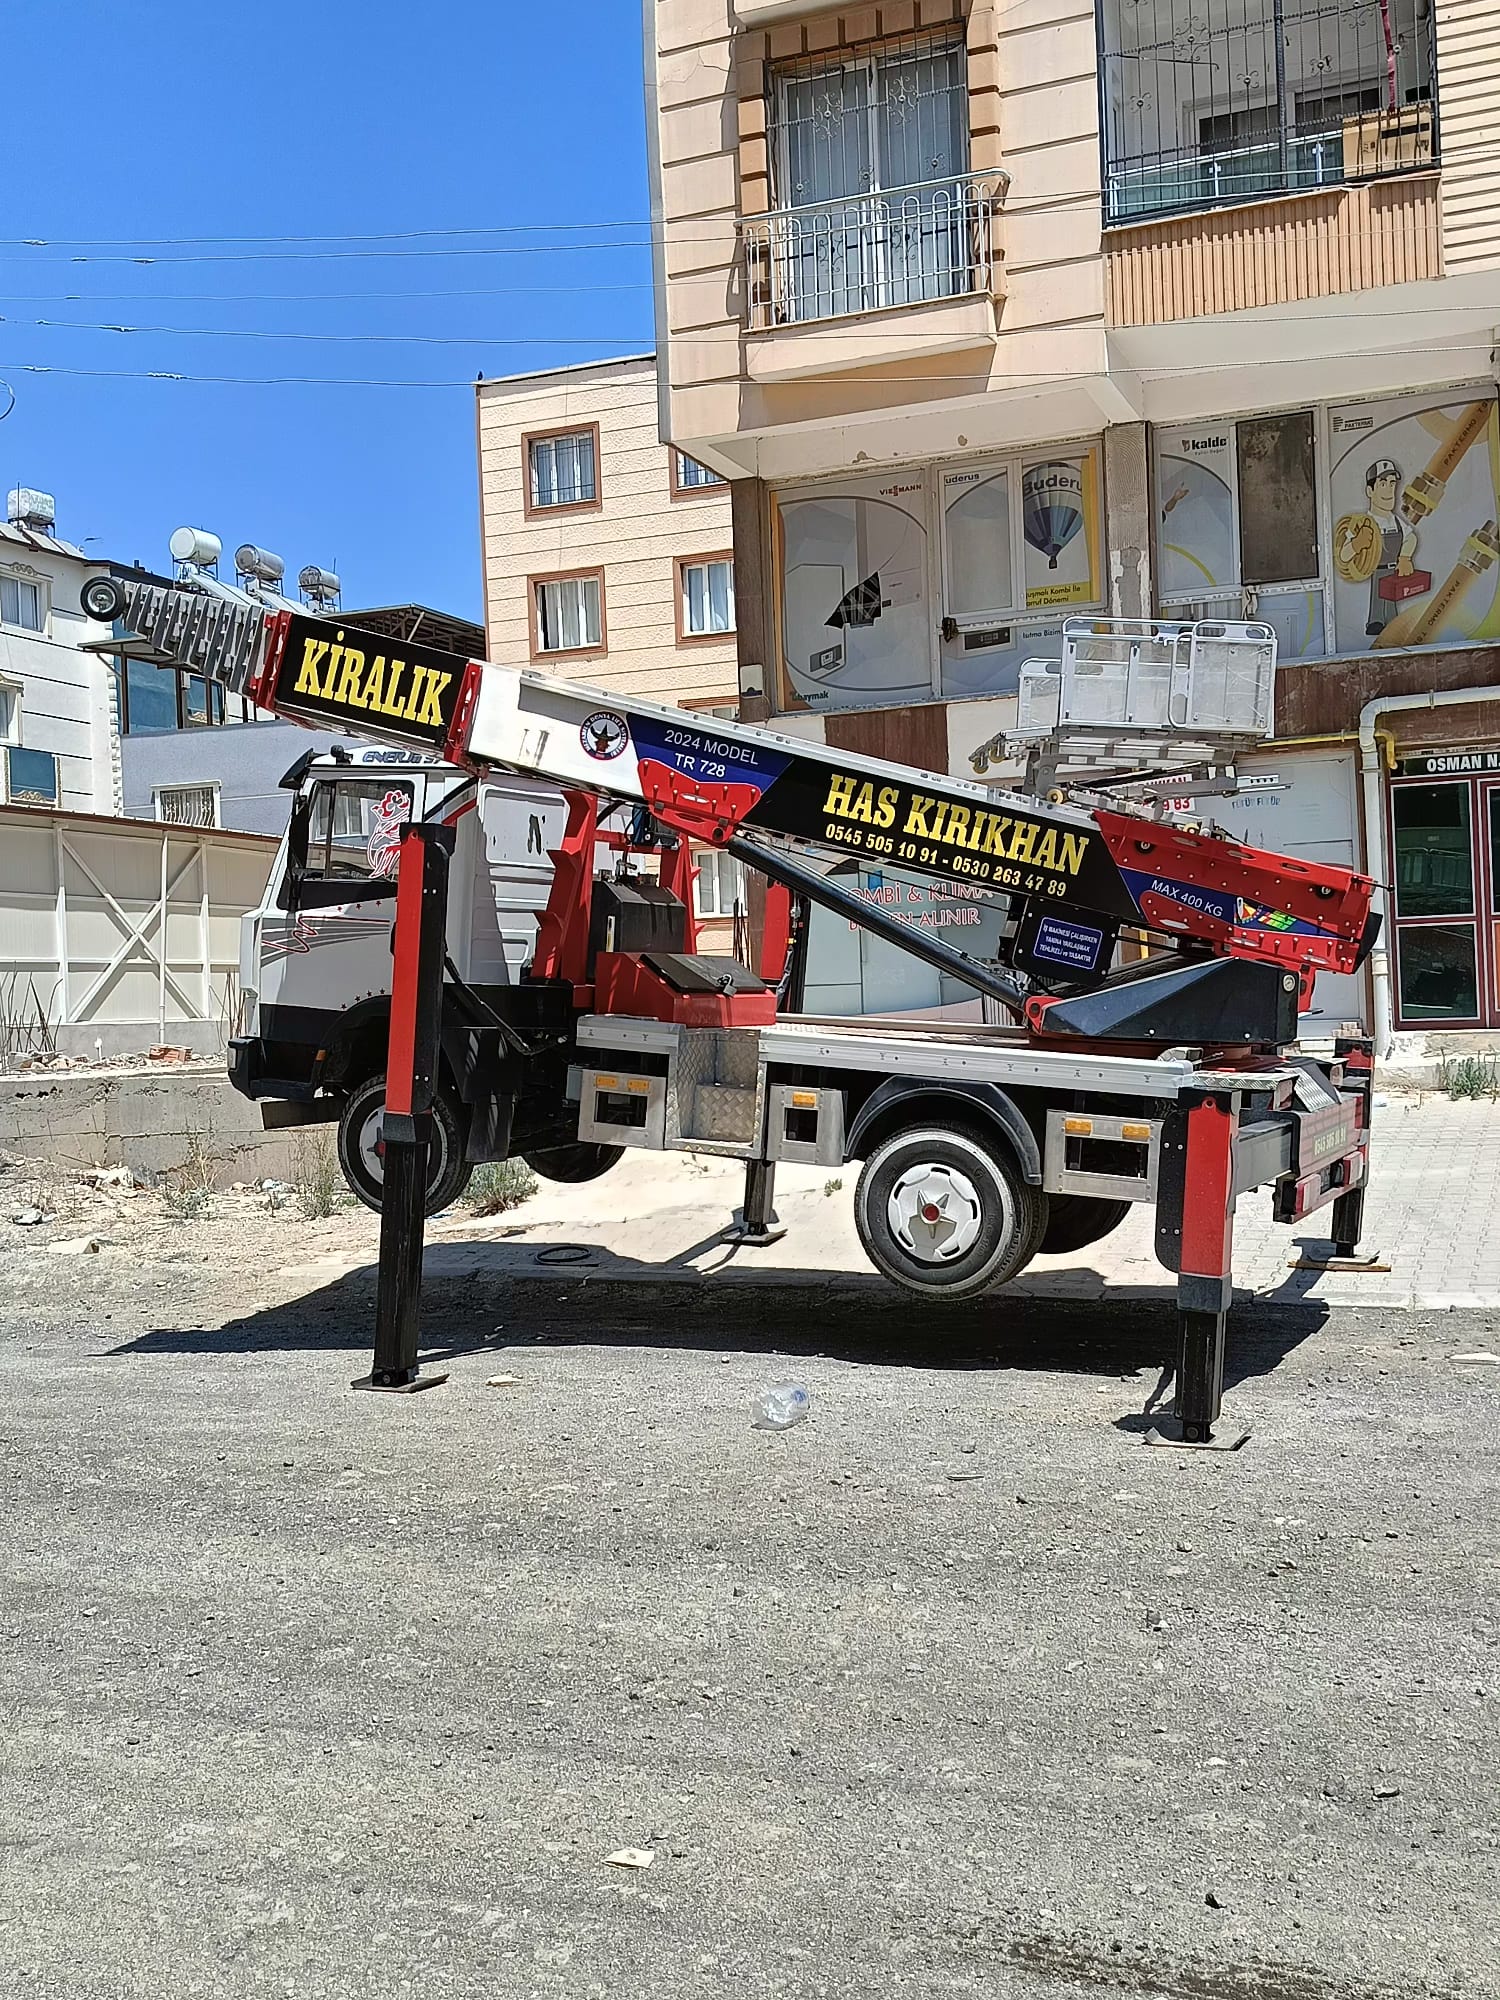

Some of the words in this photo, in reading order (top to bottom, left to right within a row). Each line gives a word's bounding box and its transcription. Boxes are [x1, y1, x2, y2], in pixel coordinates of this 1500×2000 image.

[1043, 594, 1069, 605] Dönemi
[1050, 585, 1071, 595] Kombi
[1043, 629, 1061, 637] Bizim
[293, 630, 453, 728] KİRALIK
[664, 729, 701, 750] 2024
[703, 739, 760, 766] MODEL
[674, 752, 695, 772] TR
[698, 759, 727, 778] 728
[1426, 754, 1482, 773] OSMAN
[822, 773, 900, 829] HAS
[902, 793, 1090, 876] KIRIKHAN
[825, 823, 862, 846] 0545
[865, 834, 894, 853] 505
[898, 841, 916, 860] 10
[919, 848, 938, 866] 91
[952, 855, 990, 879] 0530
[992, 865, 1021, 887] 263
[1024, 873, 1044, 891] 47
[1047, 879, 1067, 898] 89
[906, 885, 923, 902] &
[1151, 879, 1180, 898] MAX
[1180, 891, 1204, 909] 400
[1204, 902, 1224, 918] KG
[918, 907, 981, 928] ALINIR
